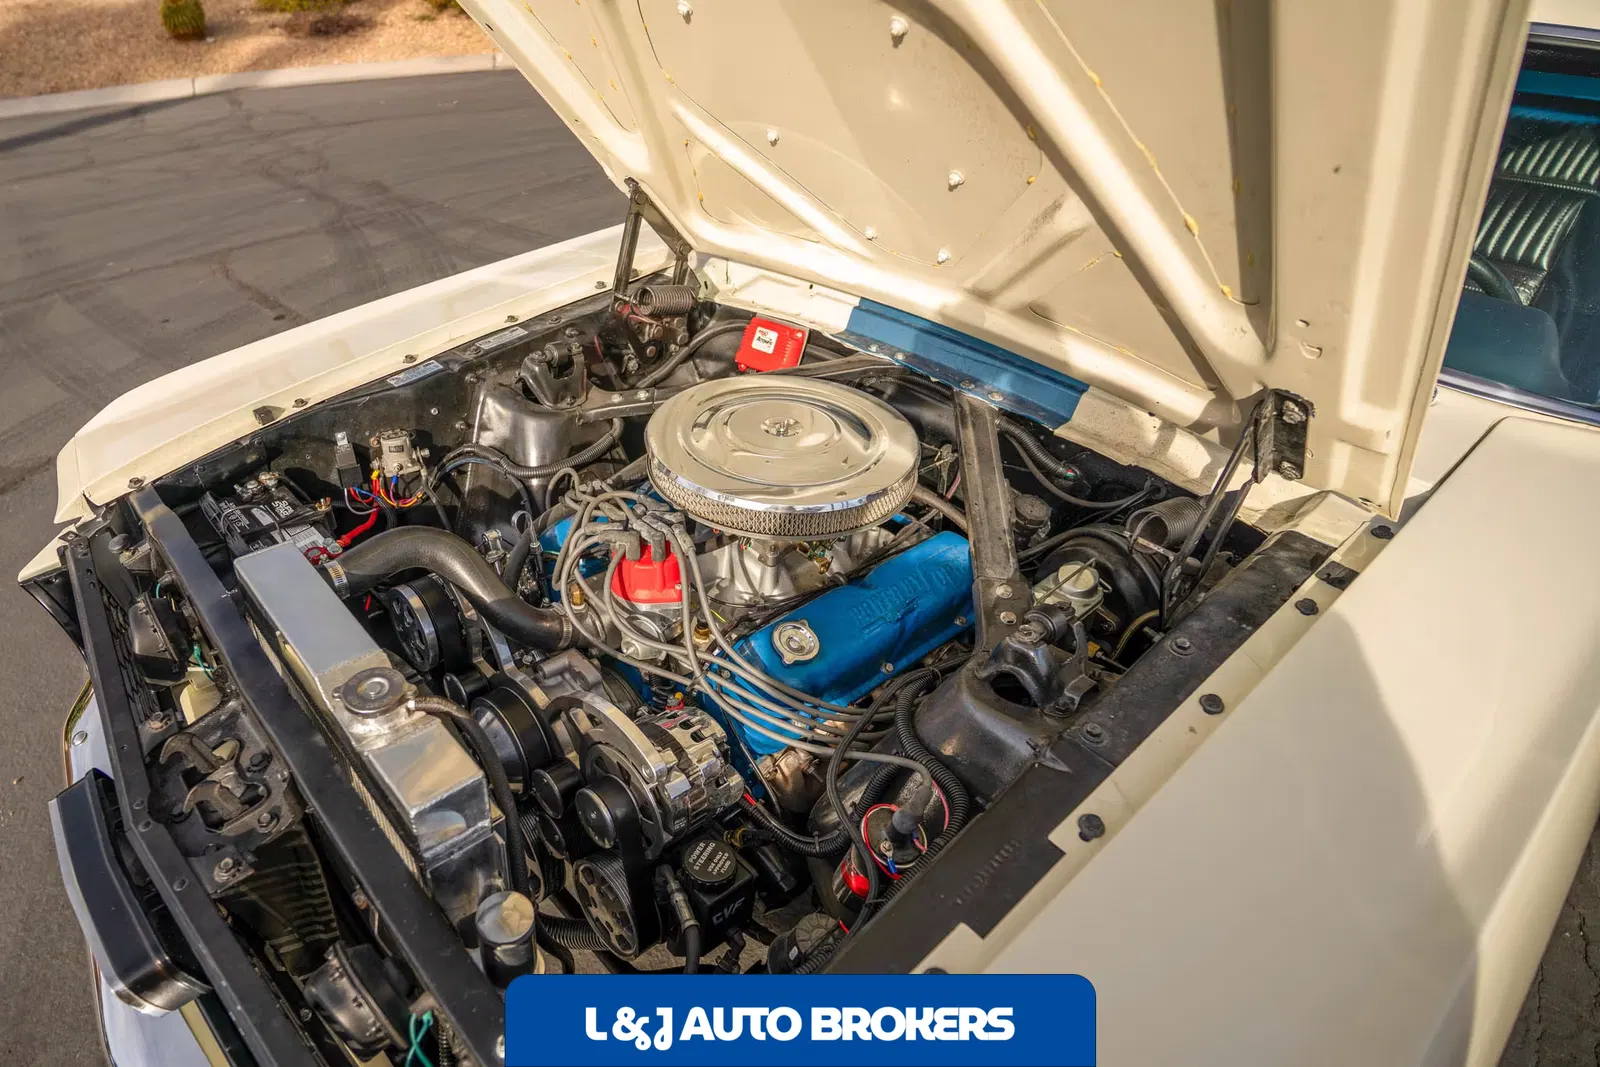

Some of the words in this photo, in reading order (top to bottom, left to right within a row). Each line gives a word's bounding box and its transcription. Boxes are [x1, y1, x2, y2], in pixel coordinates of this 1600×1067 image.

[688, 842, 706, 863] POWER
[693, 842, 716, 871] STEERING
[720, 860, 731, 873] FLUID
[712, 897, 745, 926] CVF
